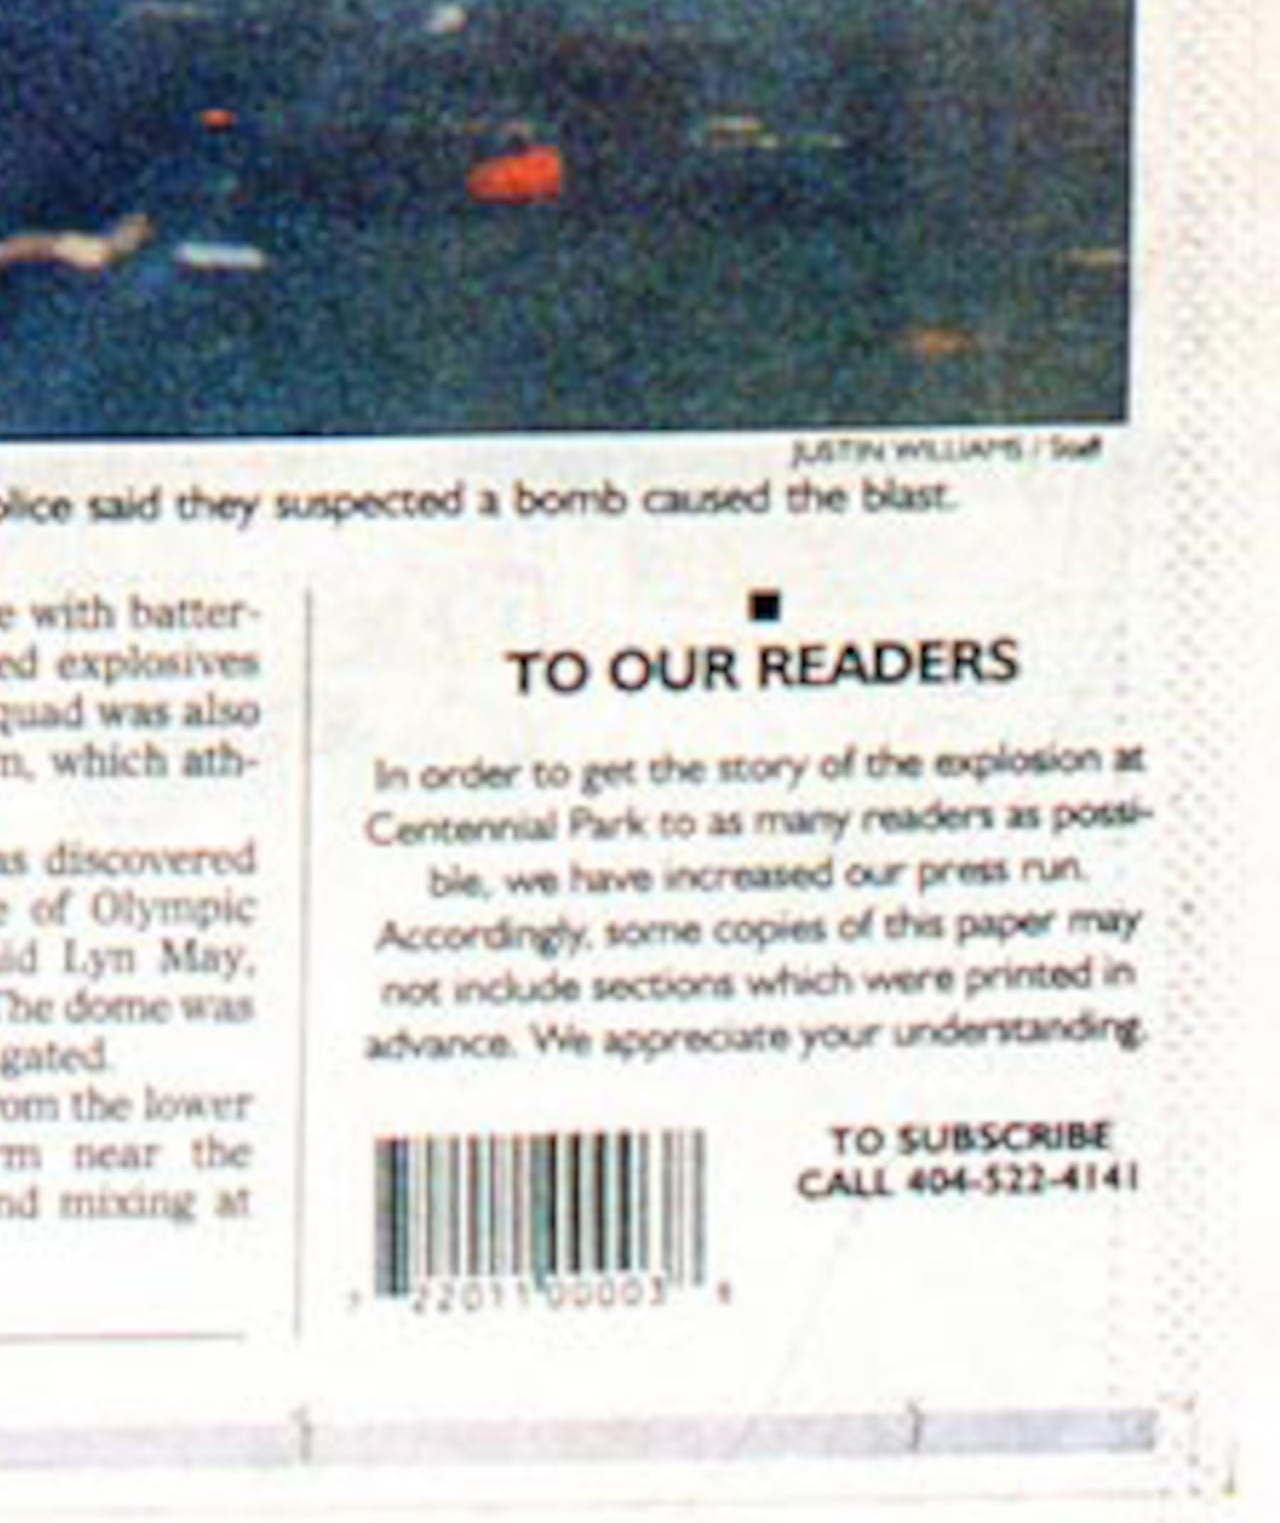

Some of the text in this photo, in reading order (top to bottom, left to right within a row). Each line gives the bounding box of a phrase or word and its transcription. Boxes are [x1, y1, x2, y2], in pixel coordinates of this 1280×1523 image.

[87, 488, 161, 522] said
[176, 487, 260, 530] they
[276, 488, 464, 524] suspected
[479, 491, 499, 516] a
[515, 486, 627, 516] bomb
[642, 484, 770, 515] caused
[786, 483, 848, 514] the
[862, 481, 956, 512] blast.
[31, 594, 115, 631] with
[130, 594, 258, 630] batter-
[507, 638, 1019, 695] TO OUR READERS
[832, 1120, 1110, 1156] TO SUBSCRIBE
[798, 1160, 1137, 1200] CALL 404-522-4141
